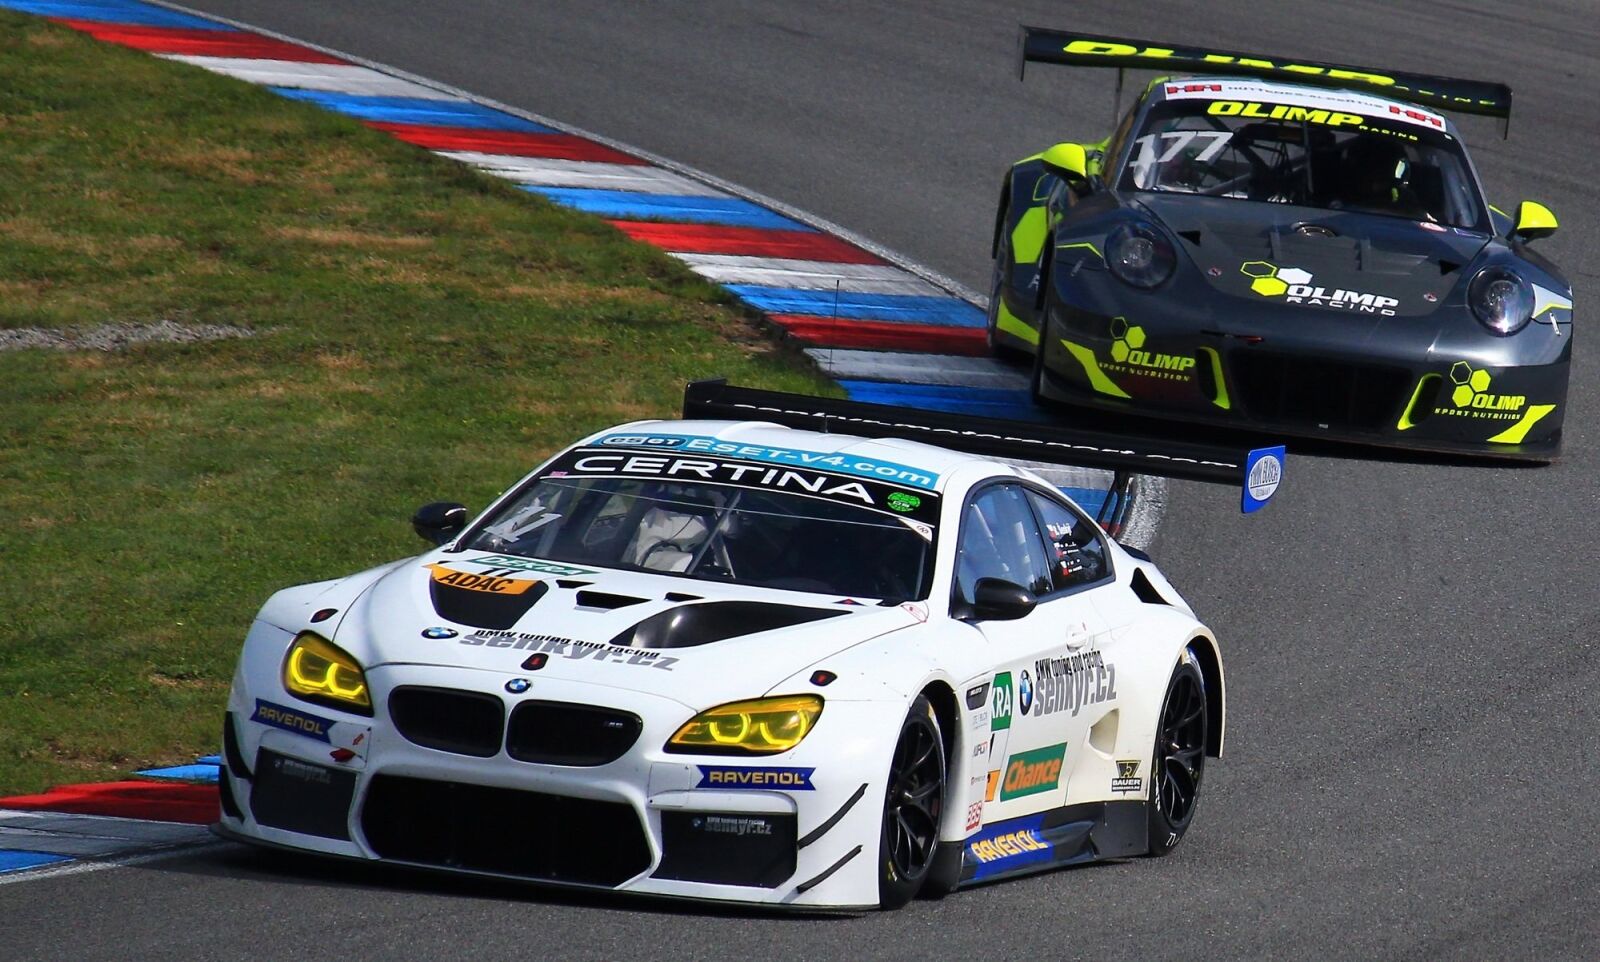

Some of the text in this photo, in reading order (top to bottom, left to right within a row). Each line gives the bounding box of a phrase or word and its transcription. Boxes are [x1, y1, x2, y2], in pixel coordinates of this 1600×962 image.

[1207, 101, 1363, 126] OLIMP
[1359, 125, 1418, 141] RACING
[1286, 284, 1399, 307] OLIMP
[1286, 296, 1396, 316] RACING
[1099, 361, 1192, 382] SPORT NUTRITION
[1128, 350, 1196, 371] OLIMP
[1434, 407, 1470, 417] SPORT
[1471, 393, 1526, 411] OLIMP
[574, 455, 876, 505] CERTINA
[438, 572, 514, 592] ADAC
[459, 634, 680, 672] senkyr.cz
[474, 629, 660, 658] BMW tuning and racing
[1035, 658, 1052, 680] BMW
[1071, 651, 1084, 673] and
[1033, 664, 1117, 718] senkyr.cz
[258, 706, 324, 735] RAVENOL
[709, 771, 805, 785] RAVENOL
[1004, 758, 1061, 792] Chance
[970, 829, 1049, 864] RAVENOL
